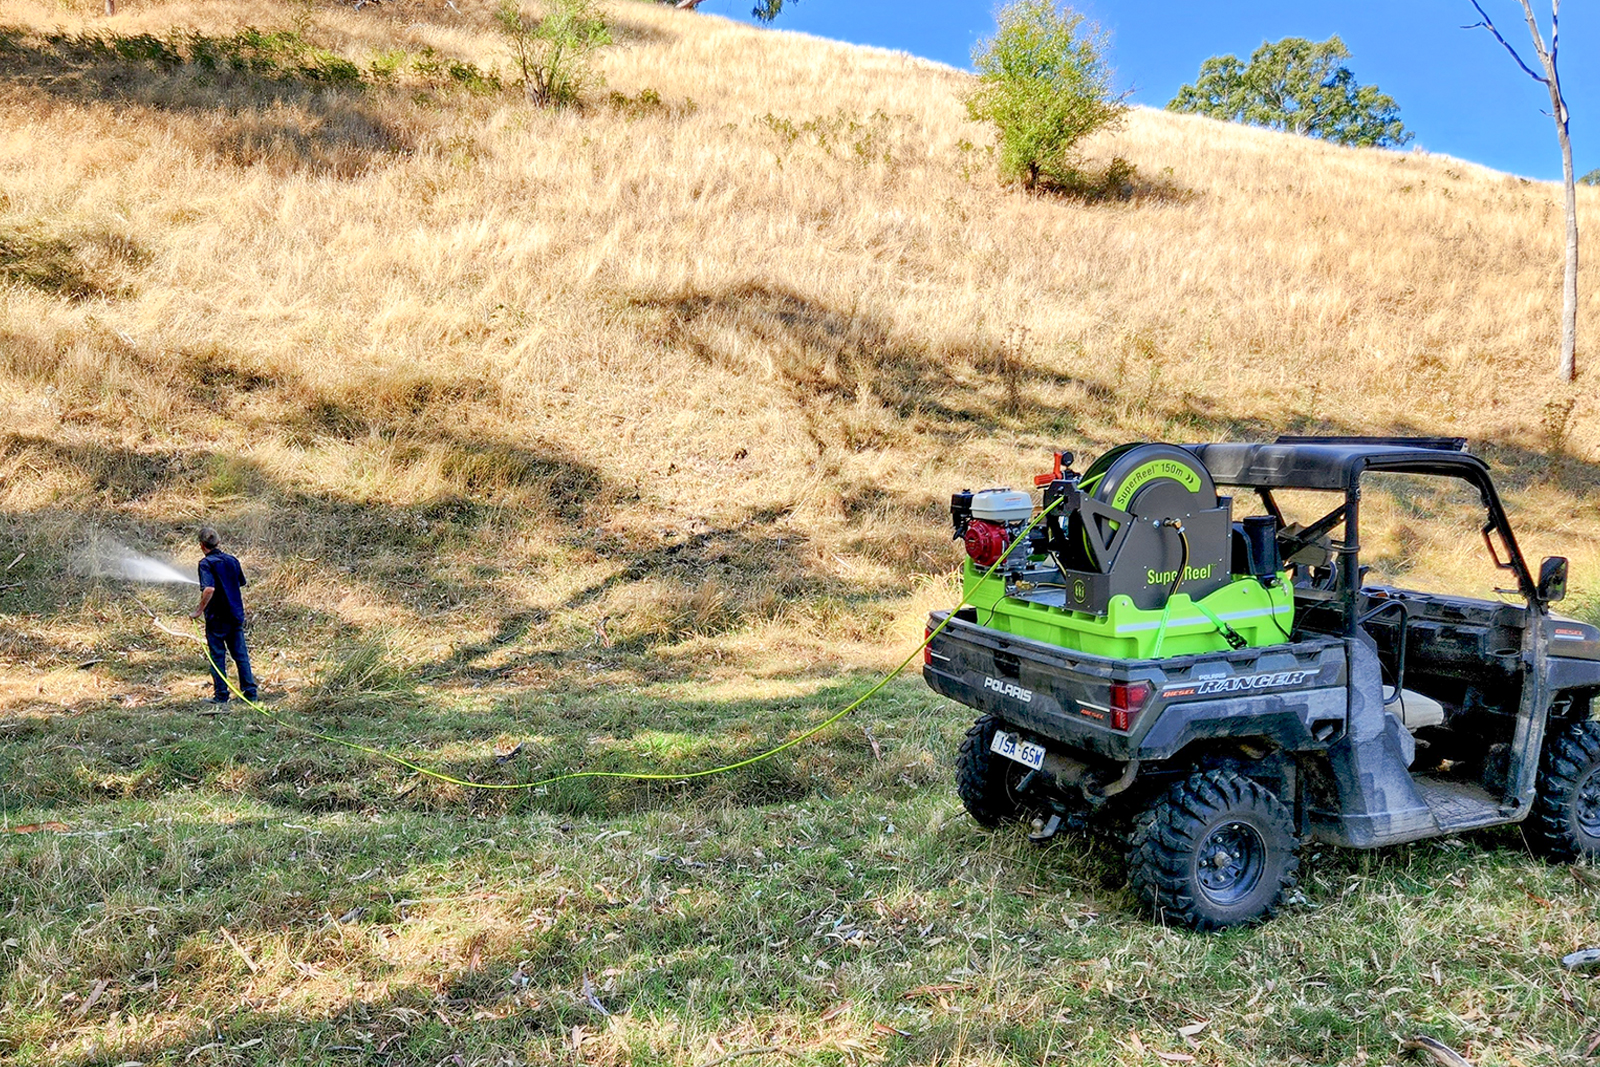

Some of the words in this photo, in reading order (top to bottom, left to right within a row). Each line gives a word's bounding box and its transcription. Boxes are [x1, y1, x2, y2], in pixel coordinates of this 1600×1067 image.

[1161, 463, 1183, 477] 150m
[1147, 564, 1212, 585] SupeReel
[984, 676, 1033, 703] POLARIS
[1162, 688, 1196, 698] DIESEL
[1197, 671, 1306, 694] RANGER
